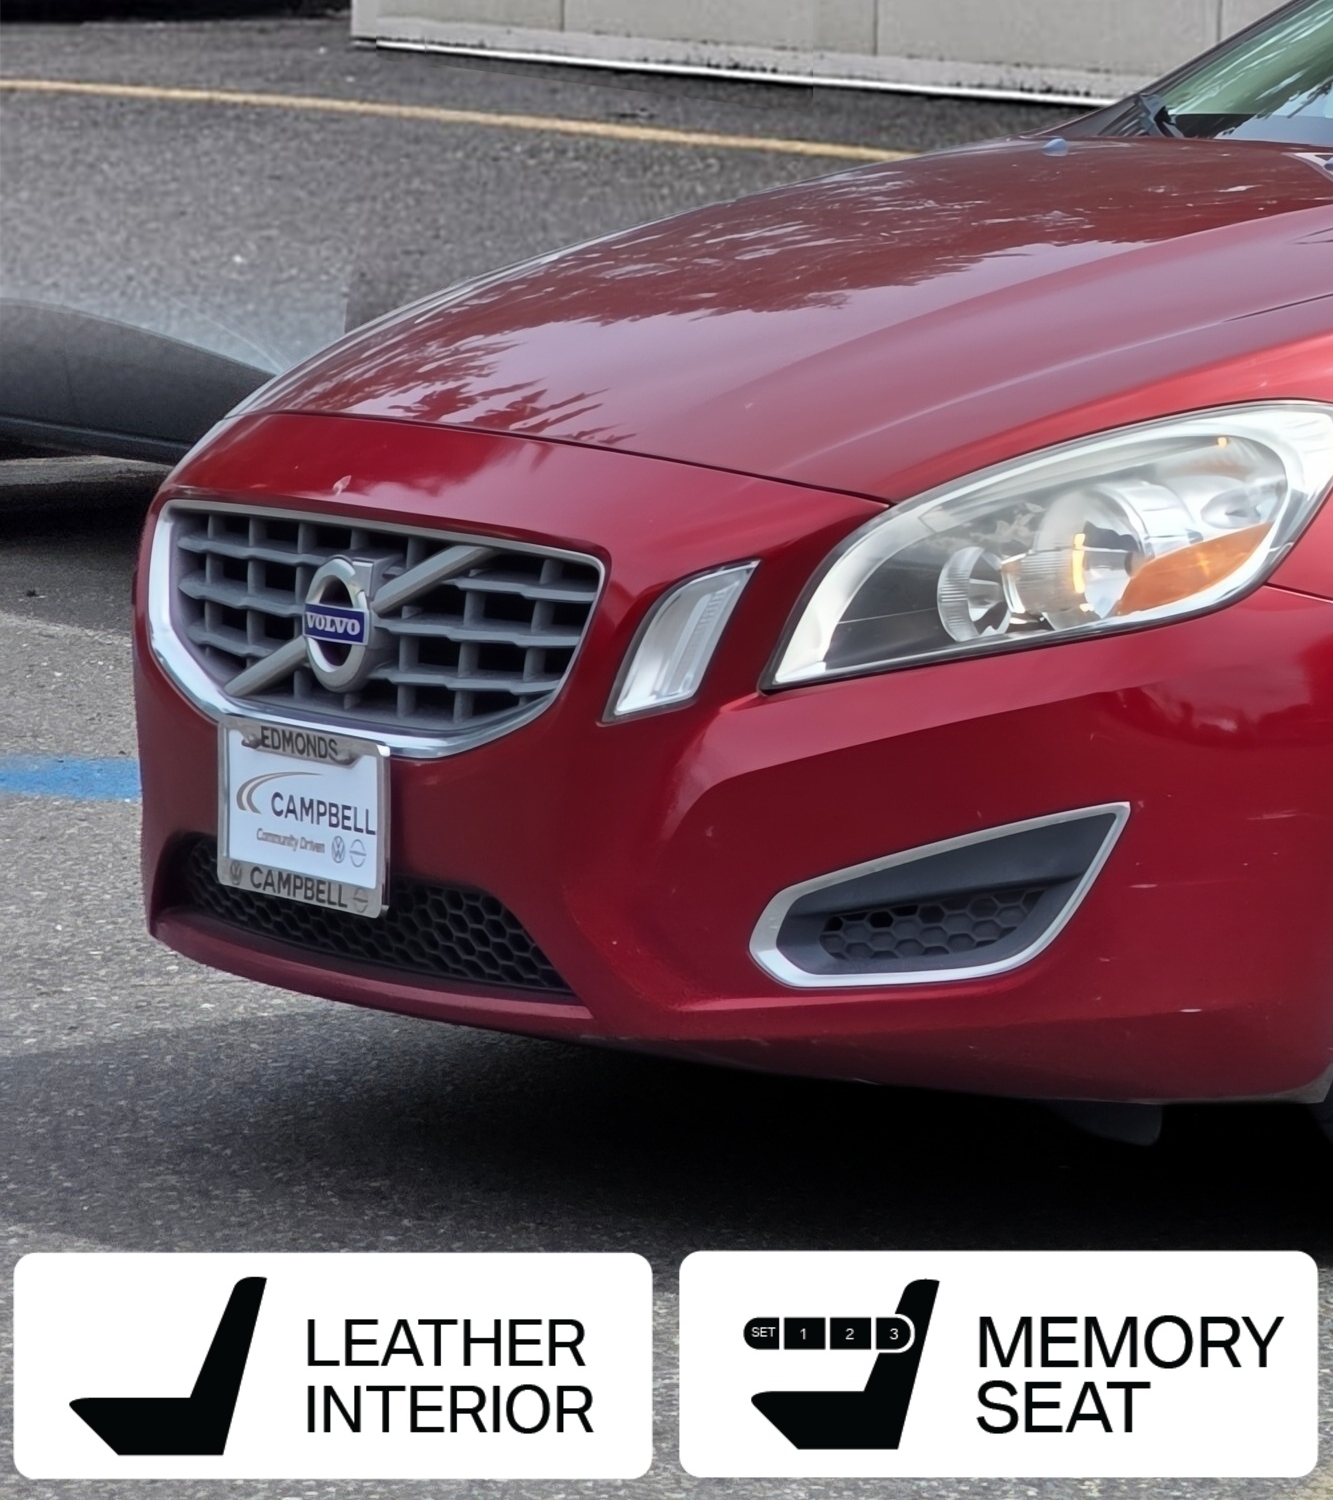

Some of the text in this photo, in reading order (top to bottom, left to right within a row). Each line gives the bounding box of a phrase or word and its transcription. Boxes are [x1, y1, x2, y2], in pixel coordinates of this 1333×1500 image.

[306, 611, 361, 636] VOLVO
[260, 725, 339, 759] EDMONDS
[271, 791, 376, 836] CAMPBELL
[249, 866, 348, 909] CAMPBELL
